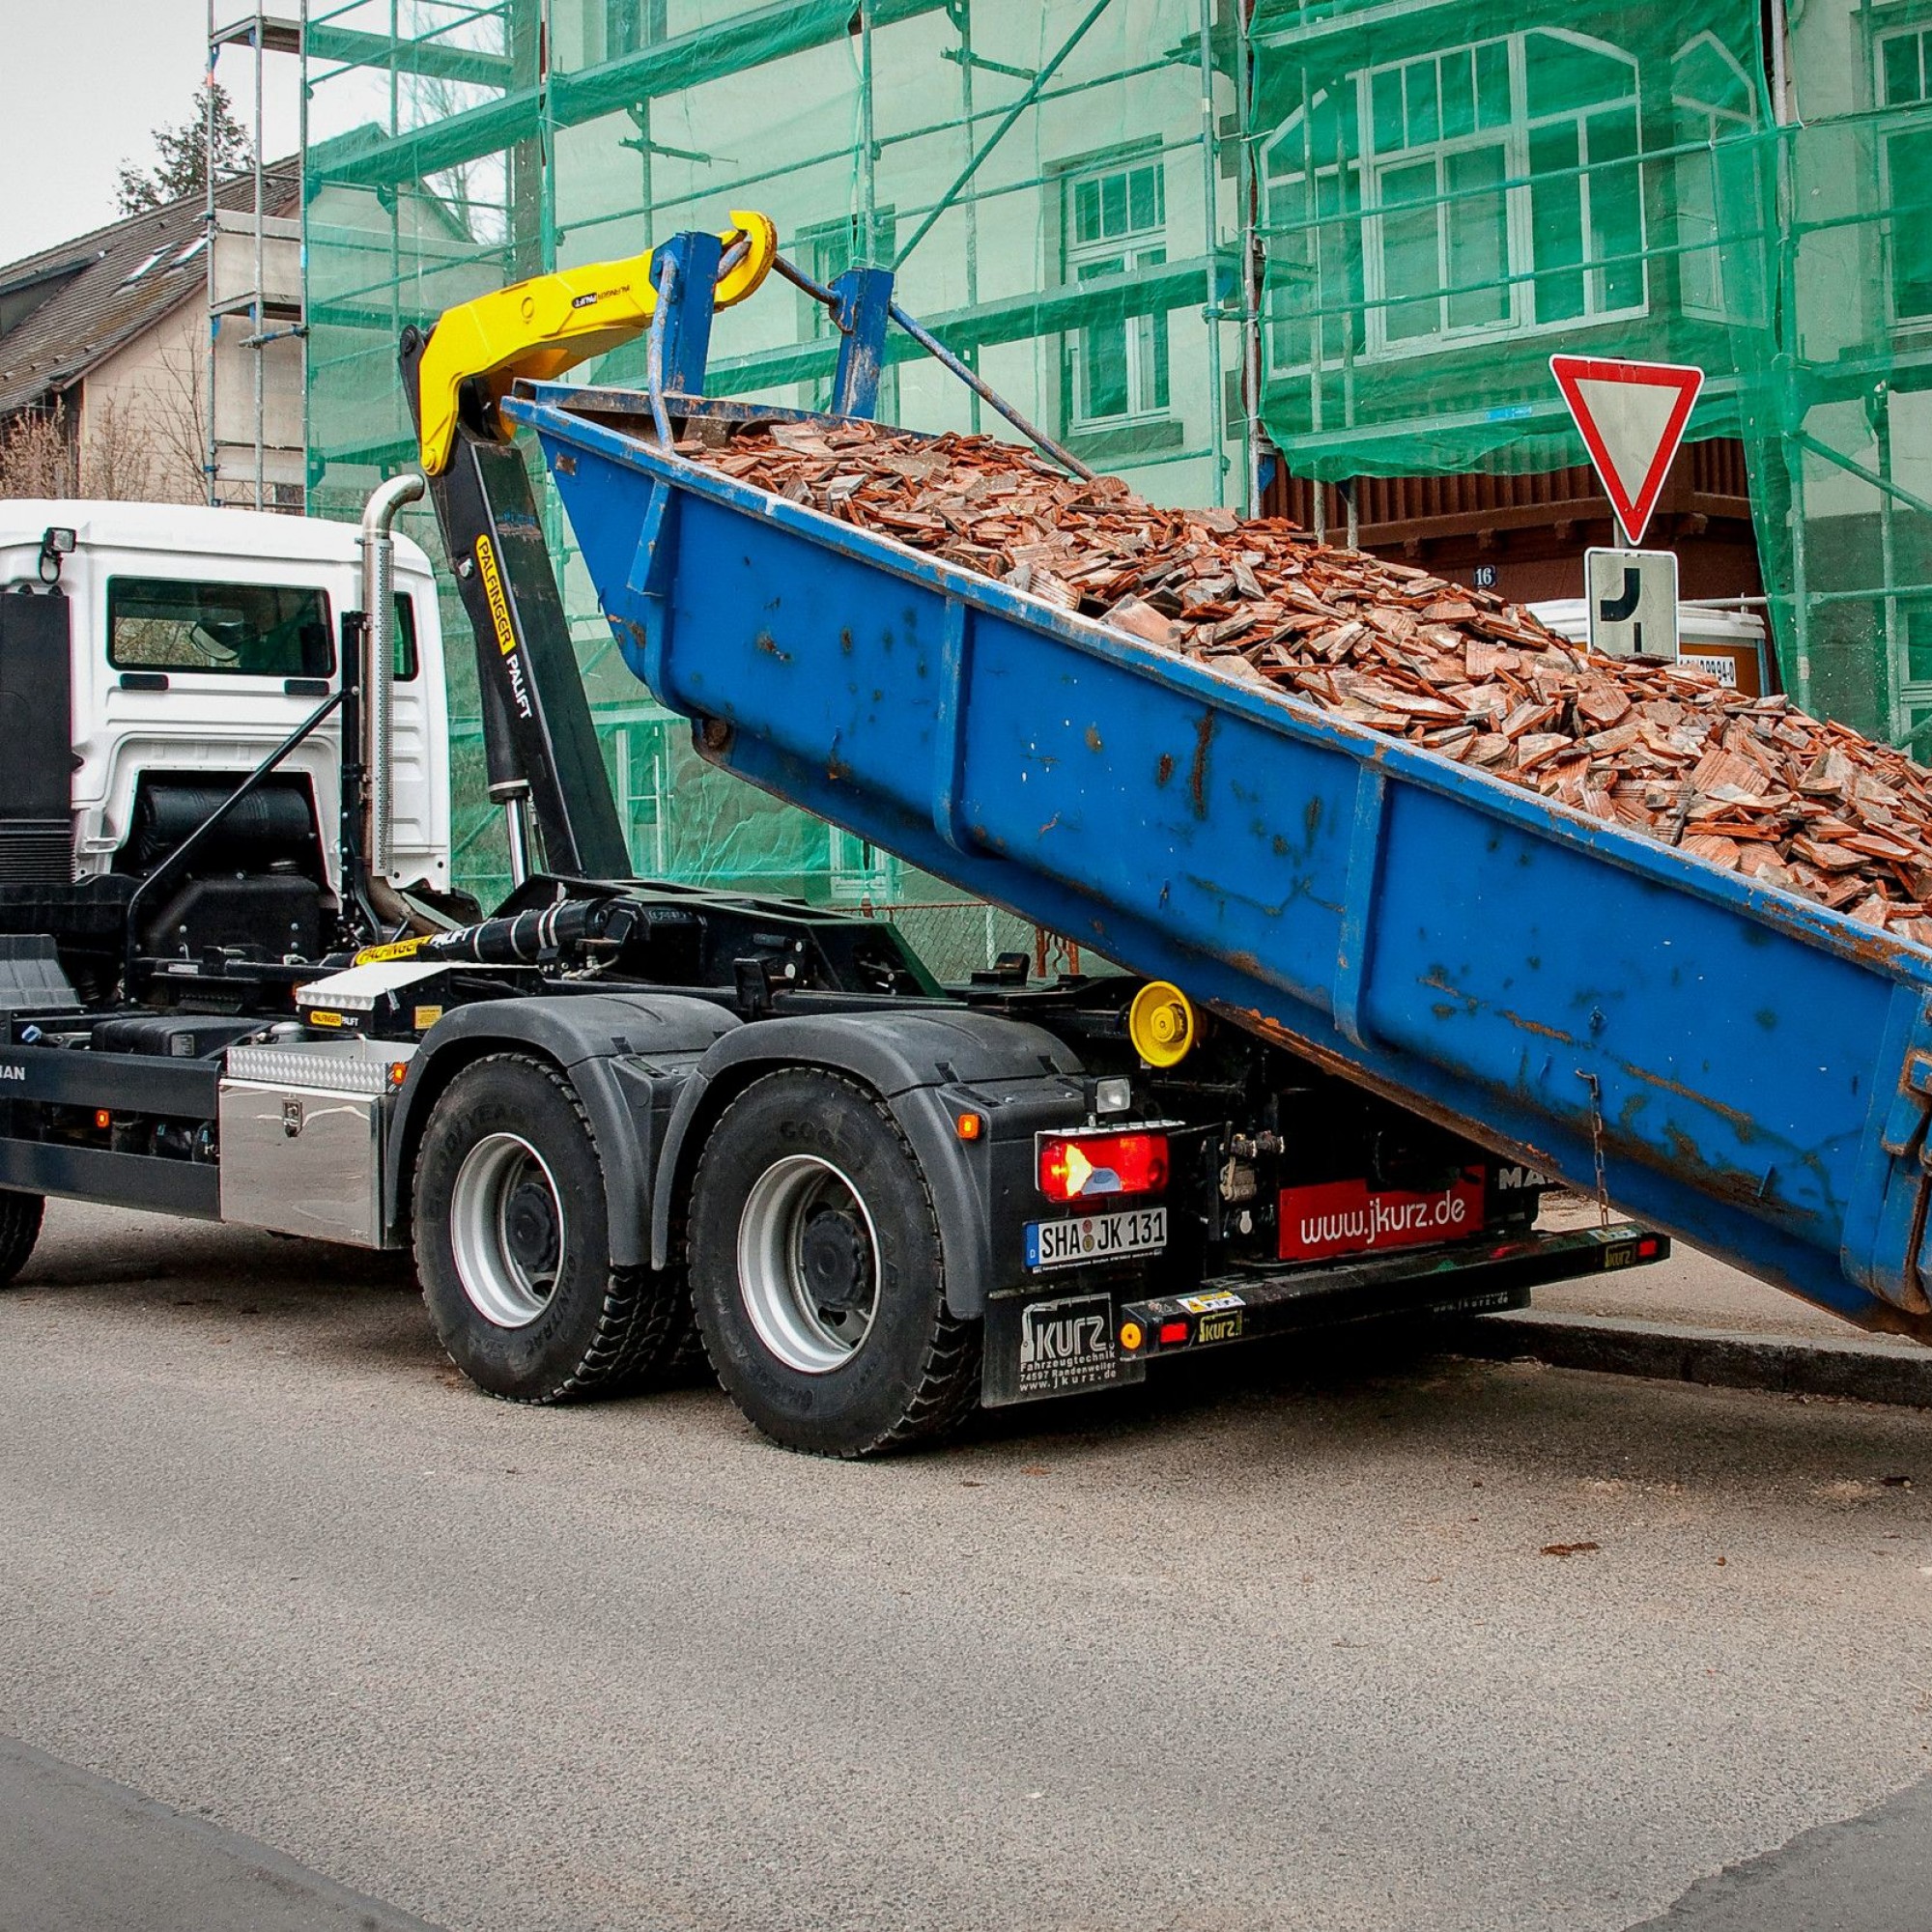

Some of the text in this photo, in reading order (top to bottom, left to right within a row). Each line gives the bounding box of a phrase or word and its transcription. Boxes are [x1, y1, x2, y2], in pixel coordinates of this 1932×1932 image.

[1475, 567, 1492, 585] 16
[477, 541, 532, 720] PALFINGER PALIFT
[1041, 1211, 1165, 1259] SHA JK 131
[1301, 1189, 1466, 1244] www.jkurz.de
[1020, 1350, 1116, 1373] Fahrzeugtechnik
